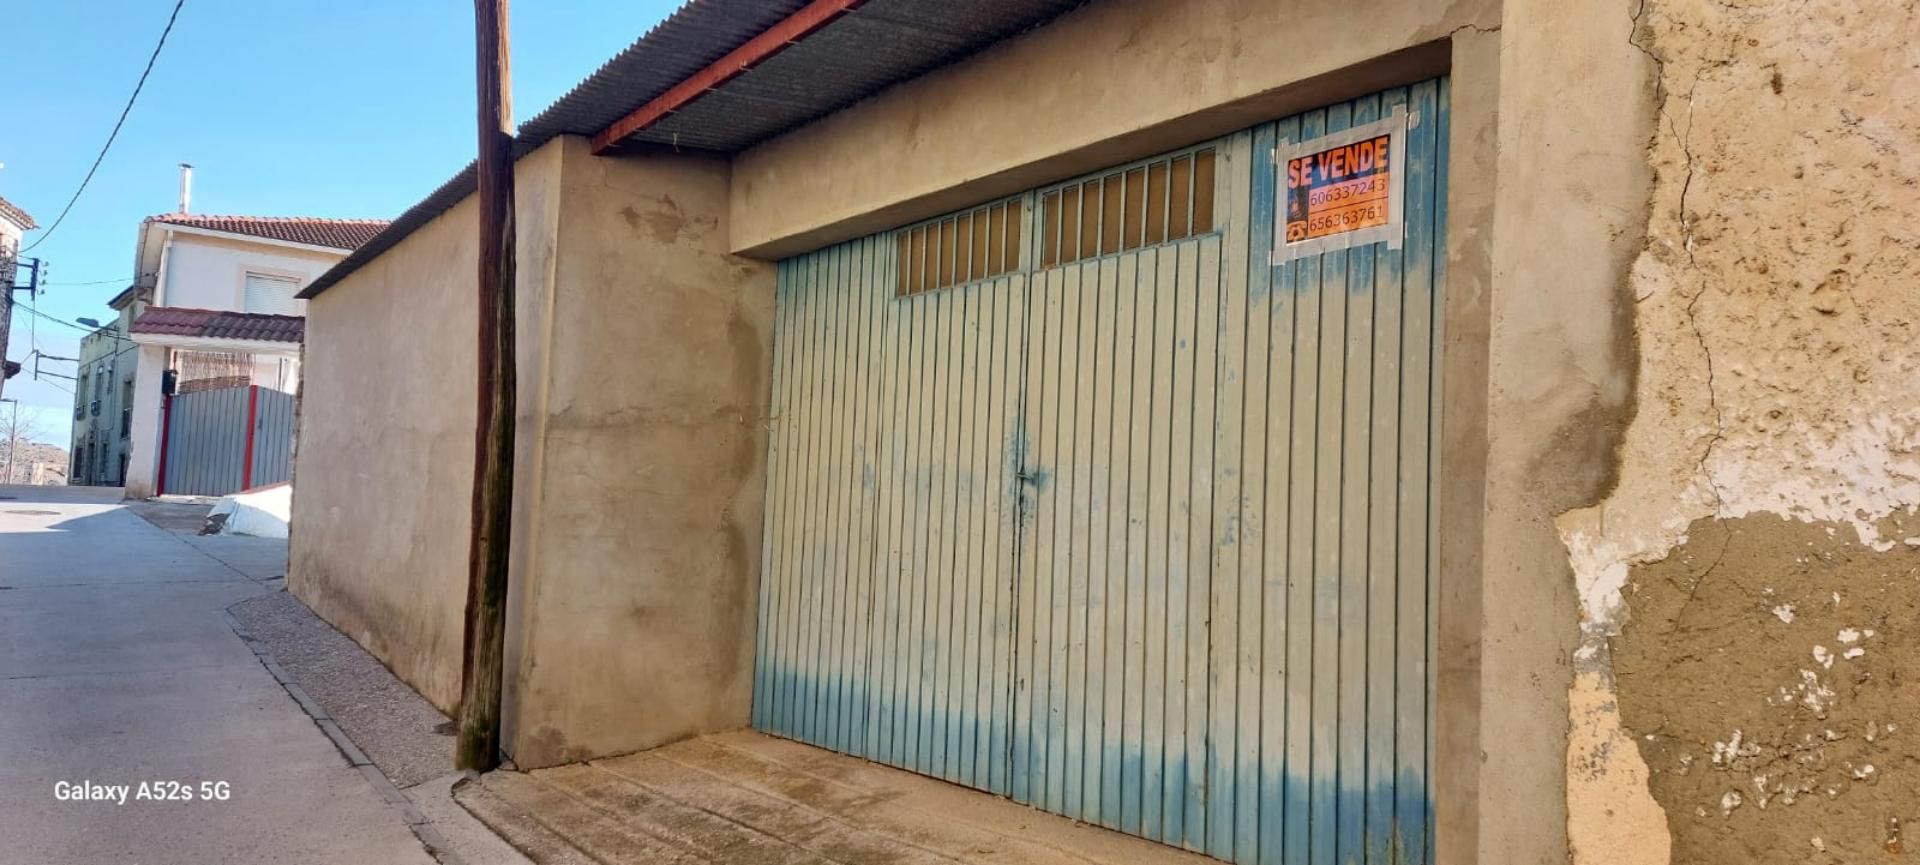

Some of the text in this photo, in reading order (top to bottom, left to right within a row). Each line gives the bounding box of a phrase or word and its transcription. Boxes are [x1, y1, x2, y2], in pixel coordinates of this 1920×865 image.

[1288, 136, 1389, 188] SE VENDE
[1311, 178, 1386, 206] 606337243
[1309, 205, 1384, 232] 656363761
